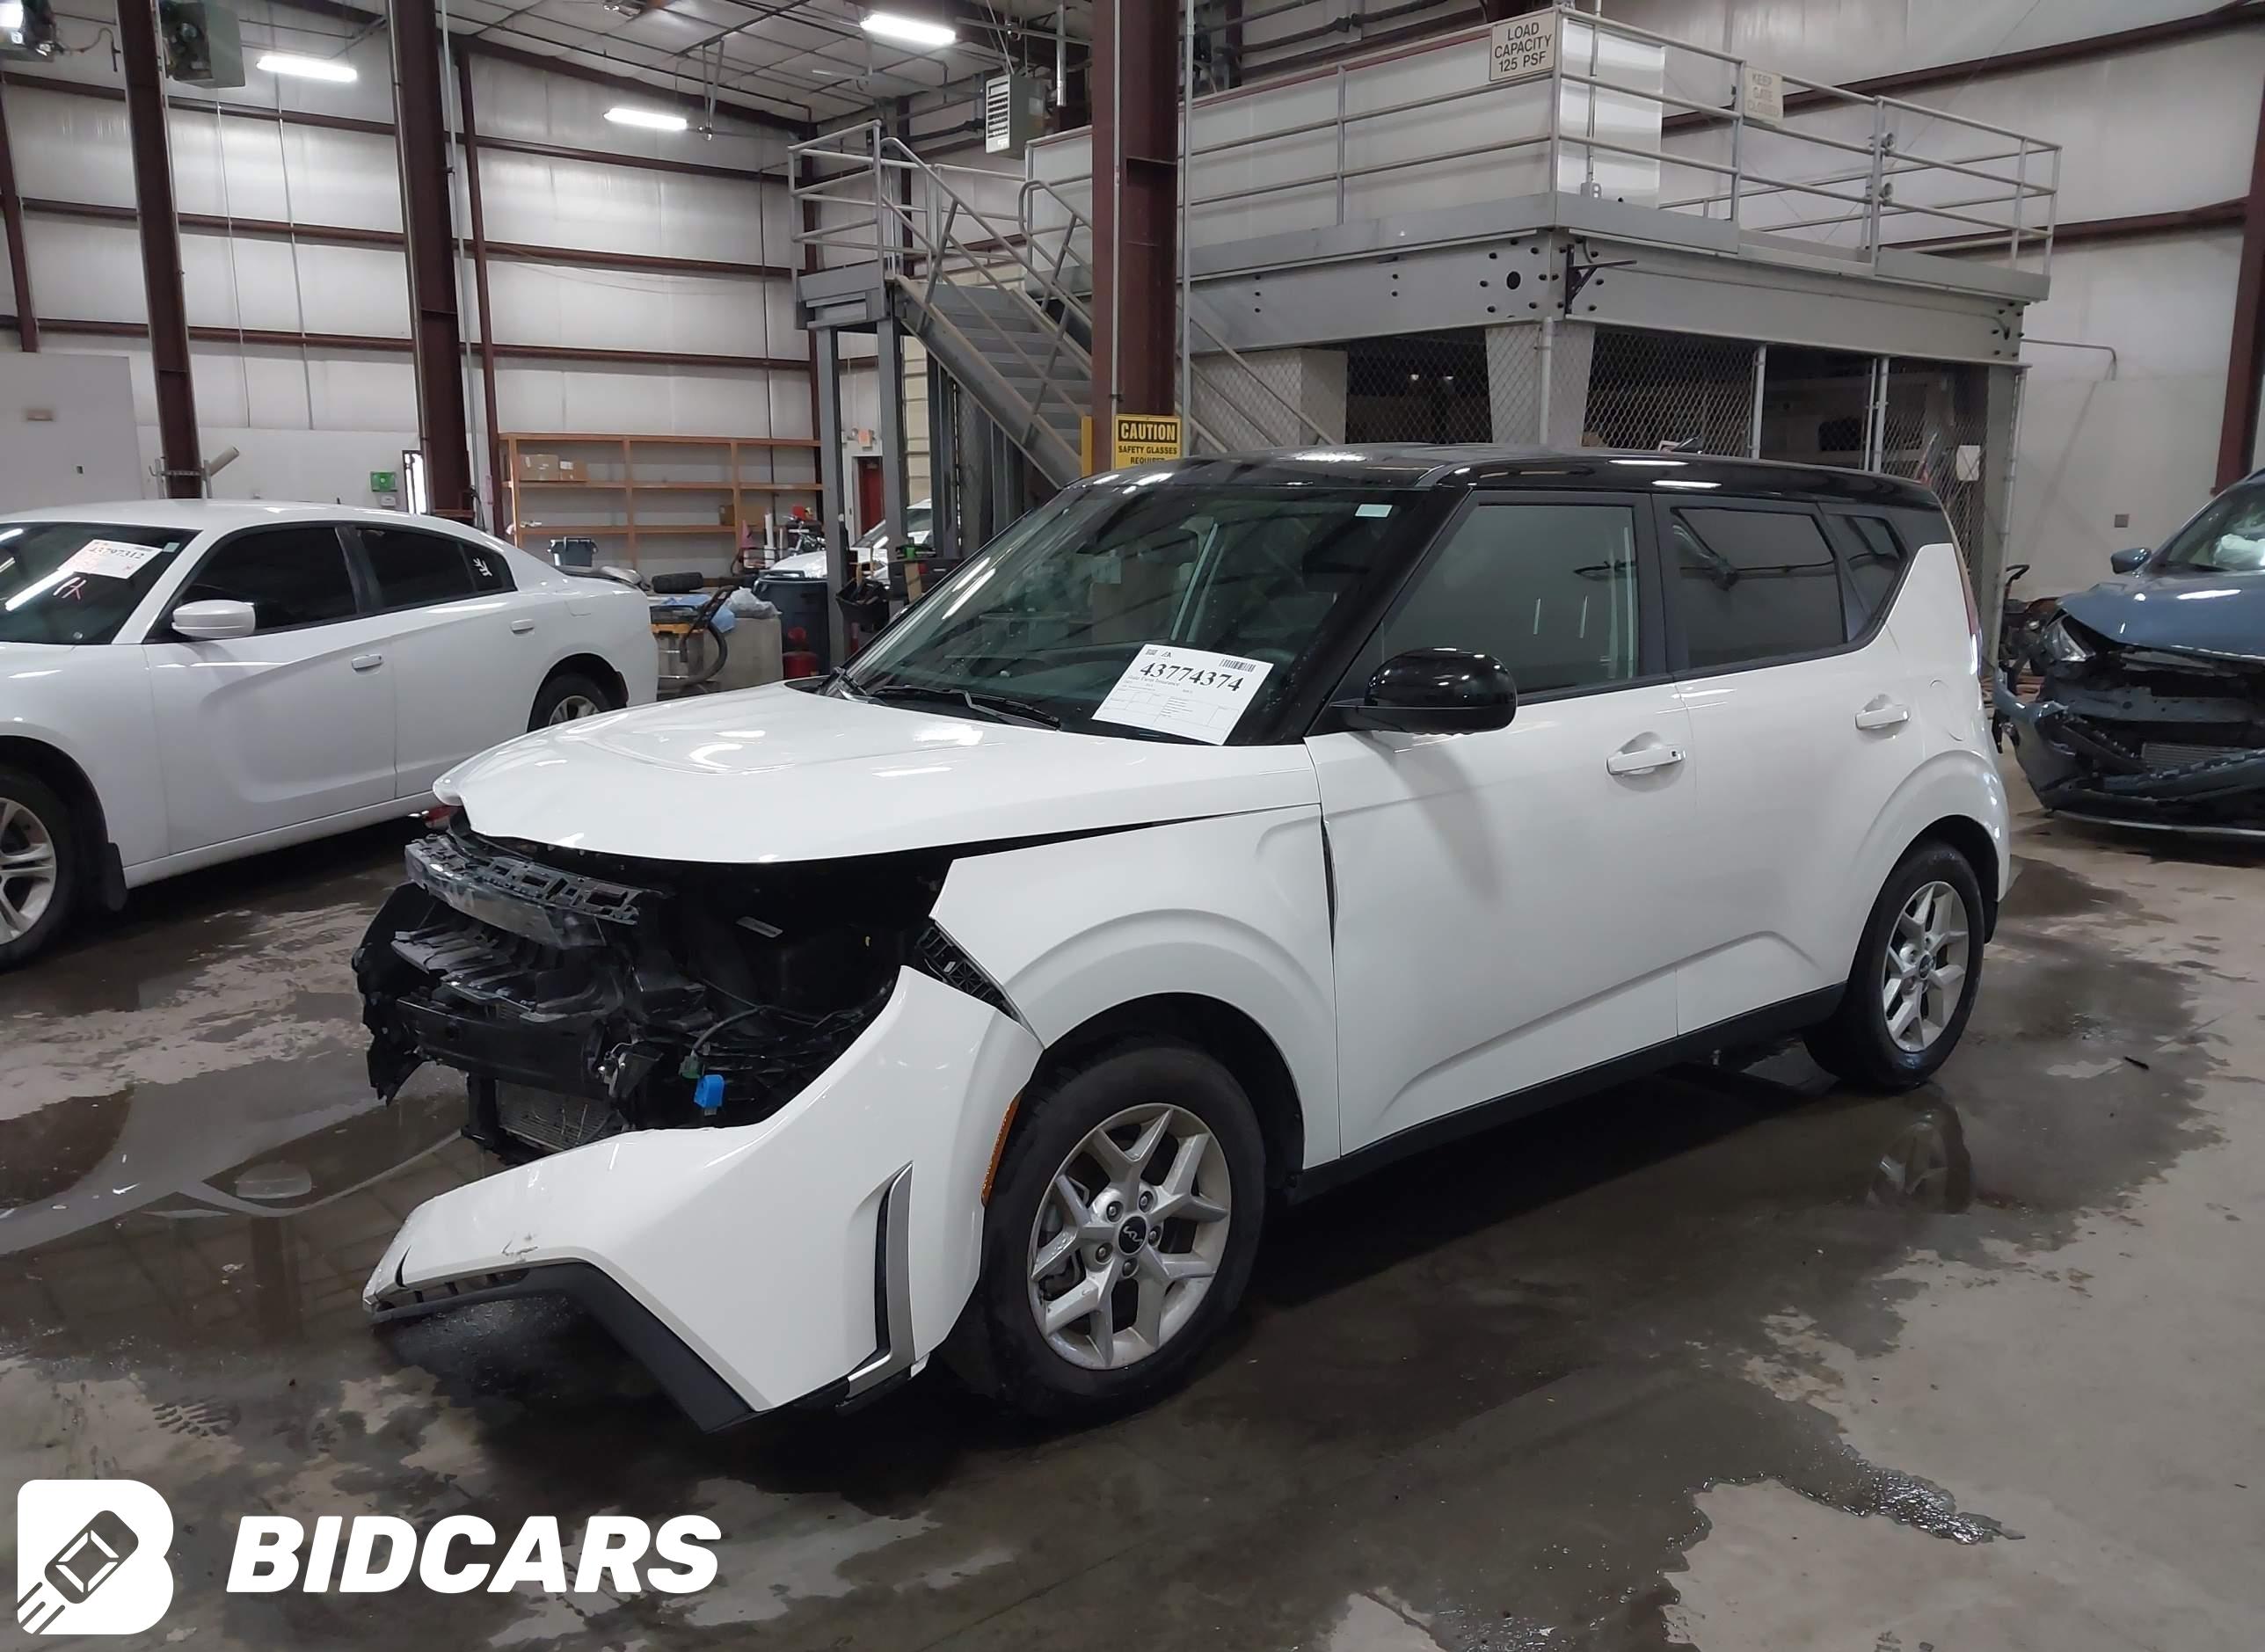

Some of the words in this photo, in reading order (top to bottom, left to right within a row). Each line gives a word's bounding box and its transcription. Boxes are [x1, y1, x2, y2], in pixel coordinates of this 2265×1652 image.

[1507, 22, 1540, 40] LOAD
[1494, 34, 1552, 59] CAPACITY
[1498, 57, 1518, 72] 125
[1523, 51, 1546, 68] PSF
[1120, 422, 1176, 440] CAUTION
[1118, 445, 1144, 454] SAFETY
[1146, 446, 1177, 455] GLASSES
[1140, 662, 1245, 692] 43774374
